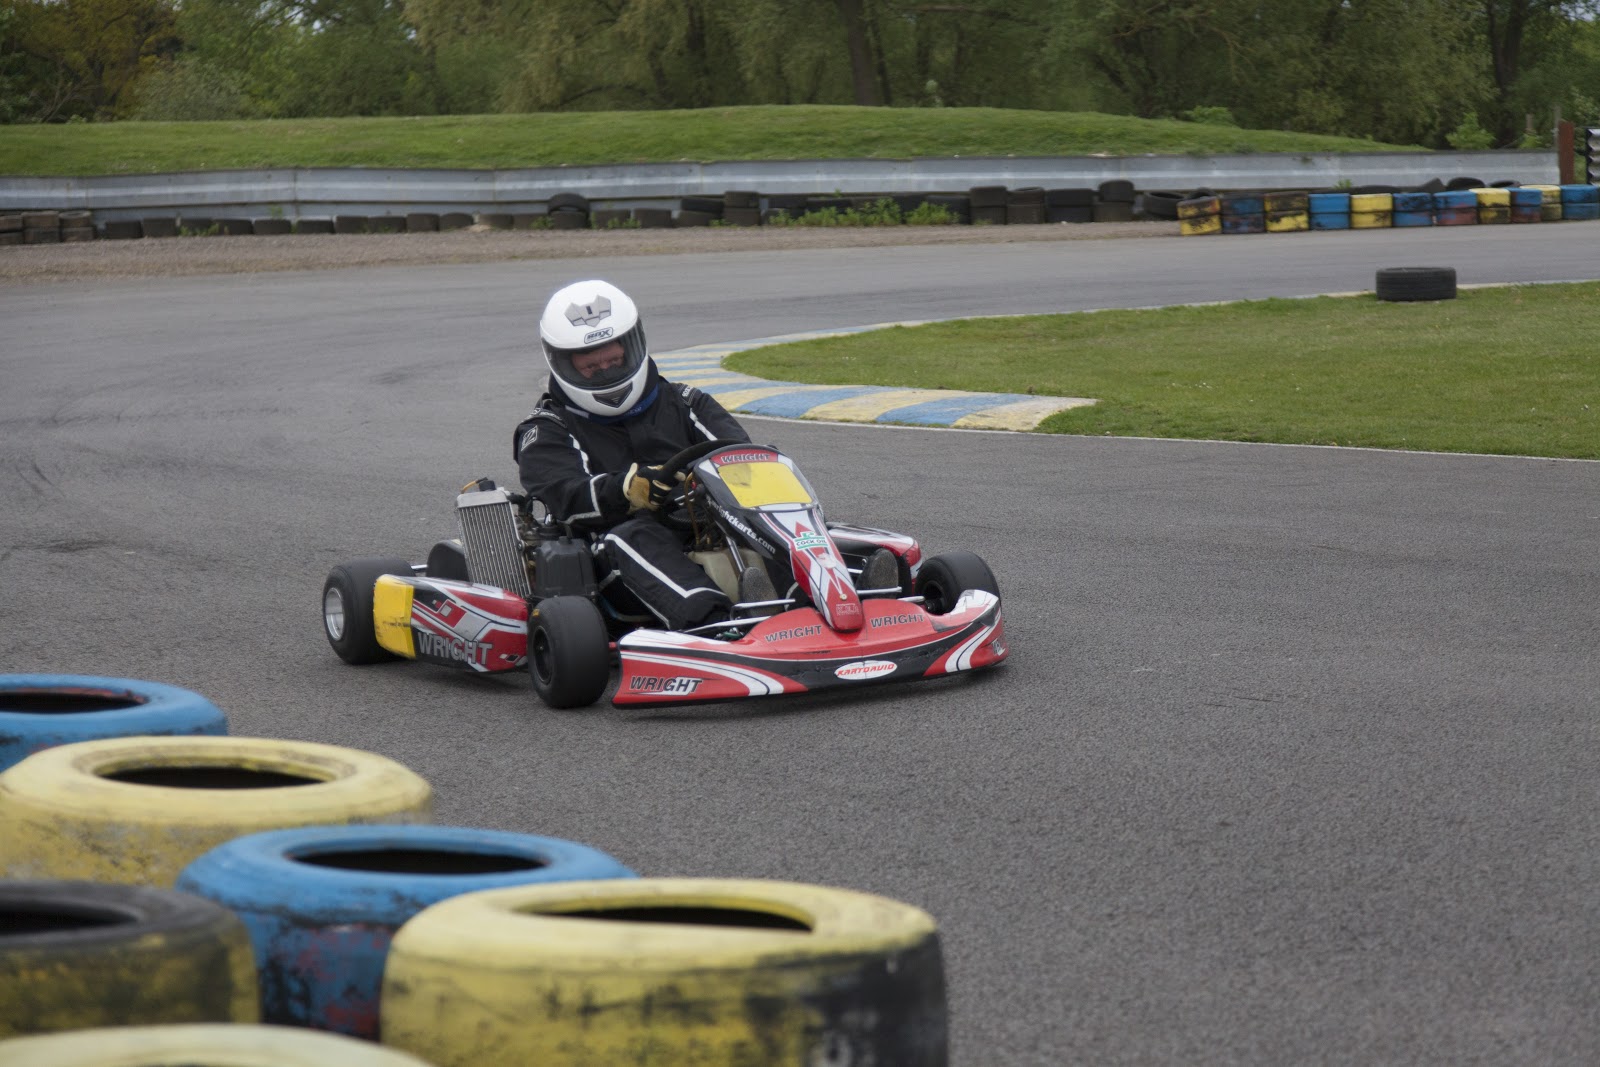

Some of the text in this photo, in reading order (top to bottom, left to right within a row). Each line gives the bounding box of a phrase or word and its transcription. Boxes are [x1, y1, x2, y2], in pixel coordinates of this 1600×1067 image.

[720, 452, 771, 464] WRIGHT
[870, 613, 926, 629] WRIGHT
[765, 625, 823, 642] WRIGHT
[417, 631, 493, 666] WRIGHT
[629, 675, 703, 693] WRIGHT
